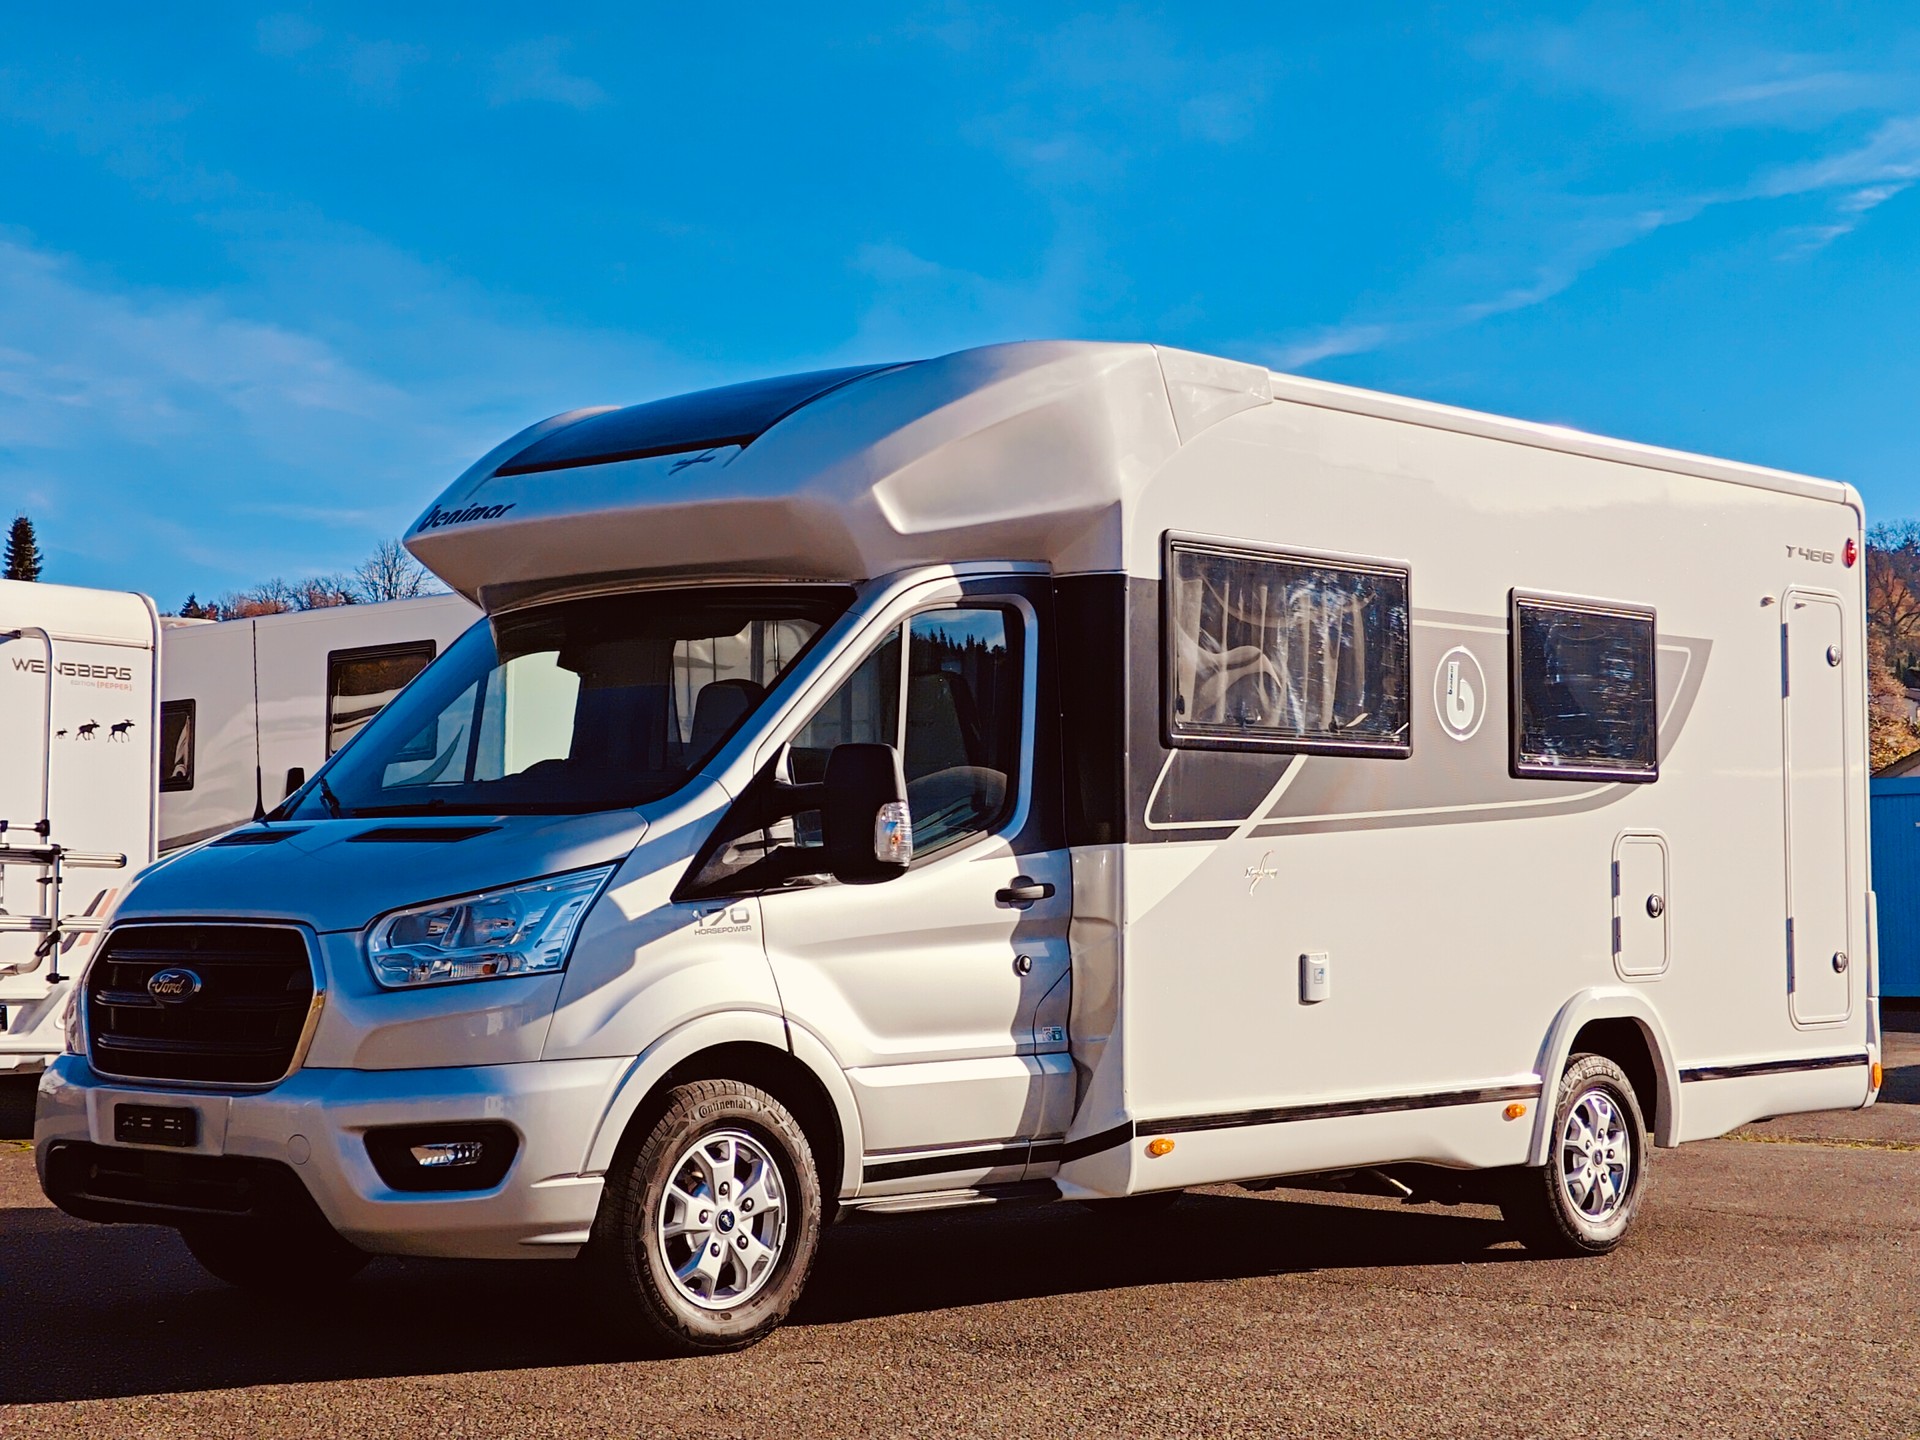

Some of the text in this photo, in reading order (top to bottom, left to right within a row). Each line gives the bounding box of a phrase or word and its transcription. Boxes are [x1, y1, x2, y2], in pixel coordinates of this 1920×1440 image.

[417, 502, 516, 533] benimar
[12, 658, 131, 681] WENSBERG
[692, 907, 750, 927] 170
[694, 925, 752, 936] HORSEPOWER
[152, 974, 186, 994] Ford
[699, 1099, 747, 1118] Continental
